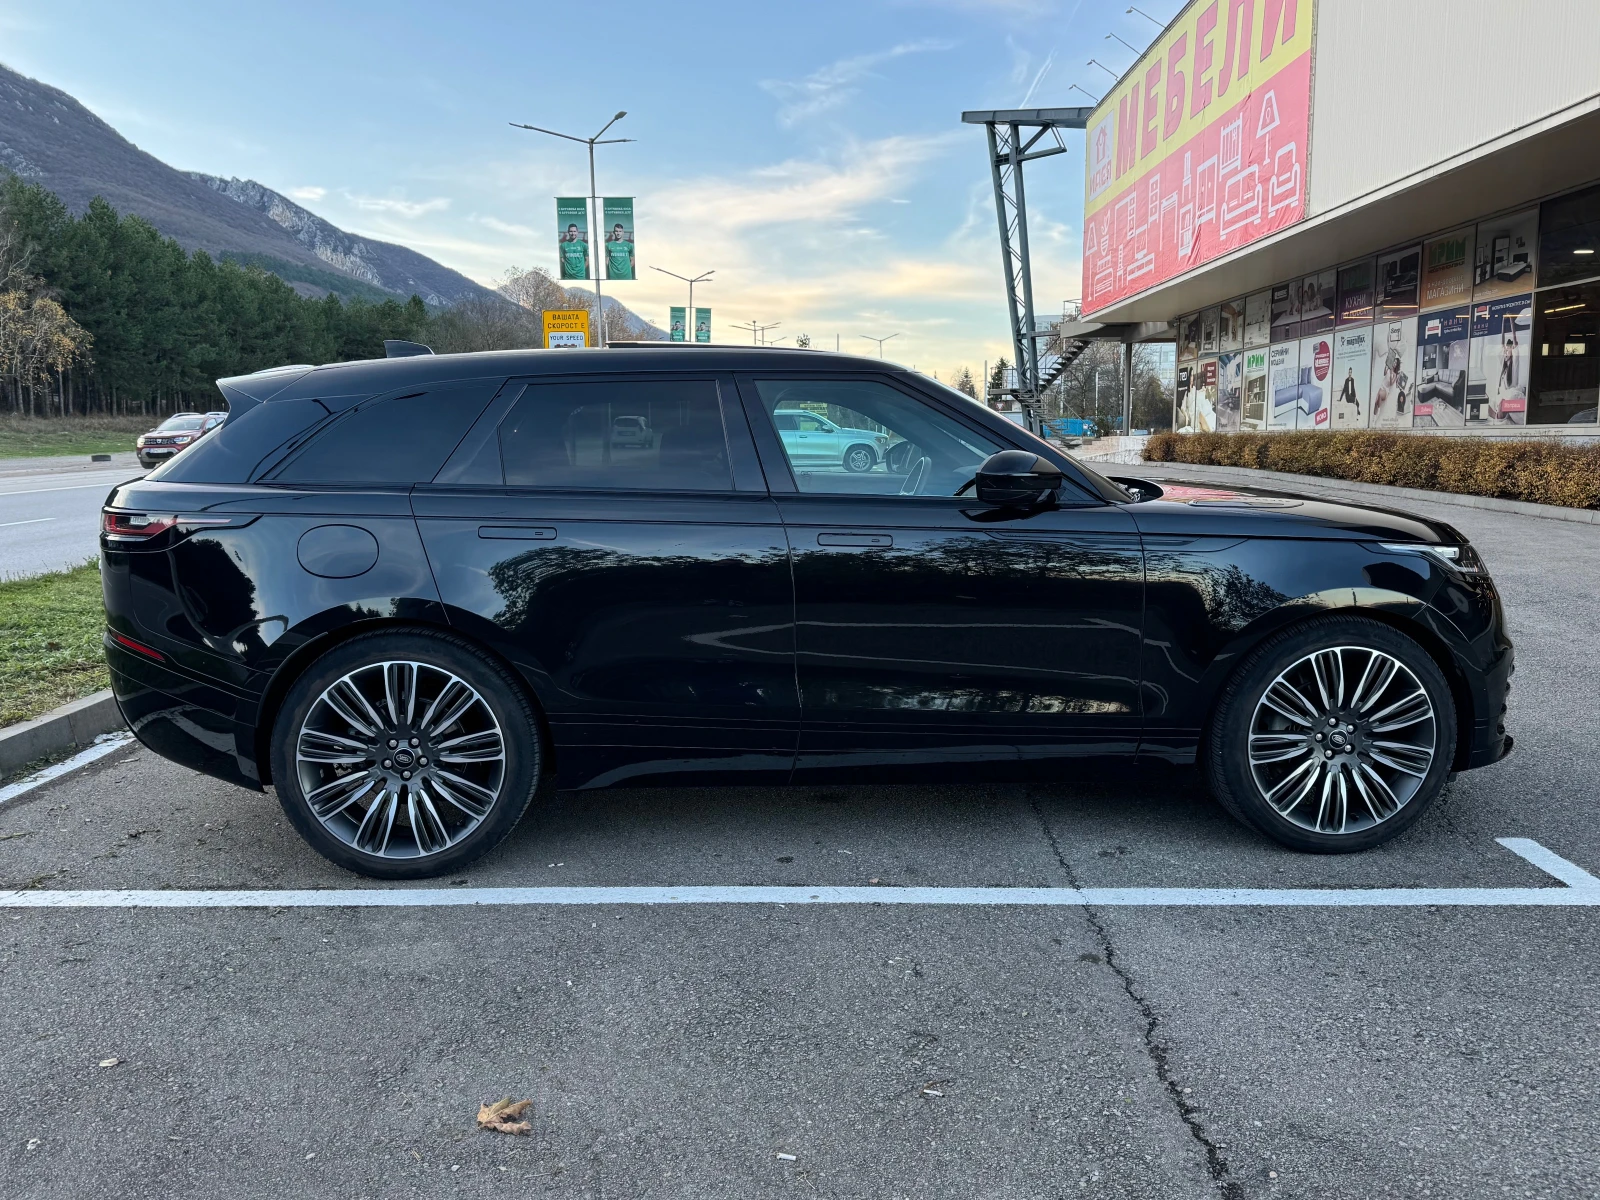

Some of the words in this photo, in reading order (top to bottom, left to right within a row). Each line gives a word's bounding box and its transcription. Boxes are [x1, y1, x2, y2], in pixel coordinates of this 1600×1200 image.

[1427, 283, 1463, 300] МАГАЗИНИ
[1345, 294, 1366, 309] КУХНИ
[1271, 347, 1289, 358] СЕРИЙНИ
[1247, 353, 1265, 369] ИРИМ
